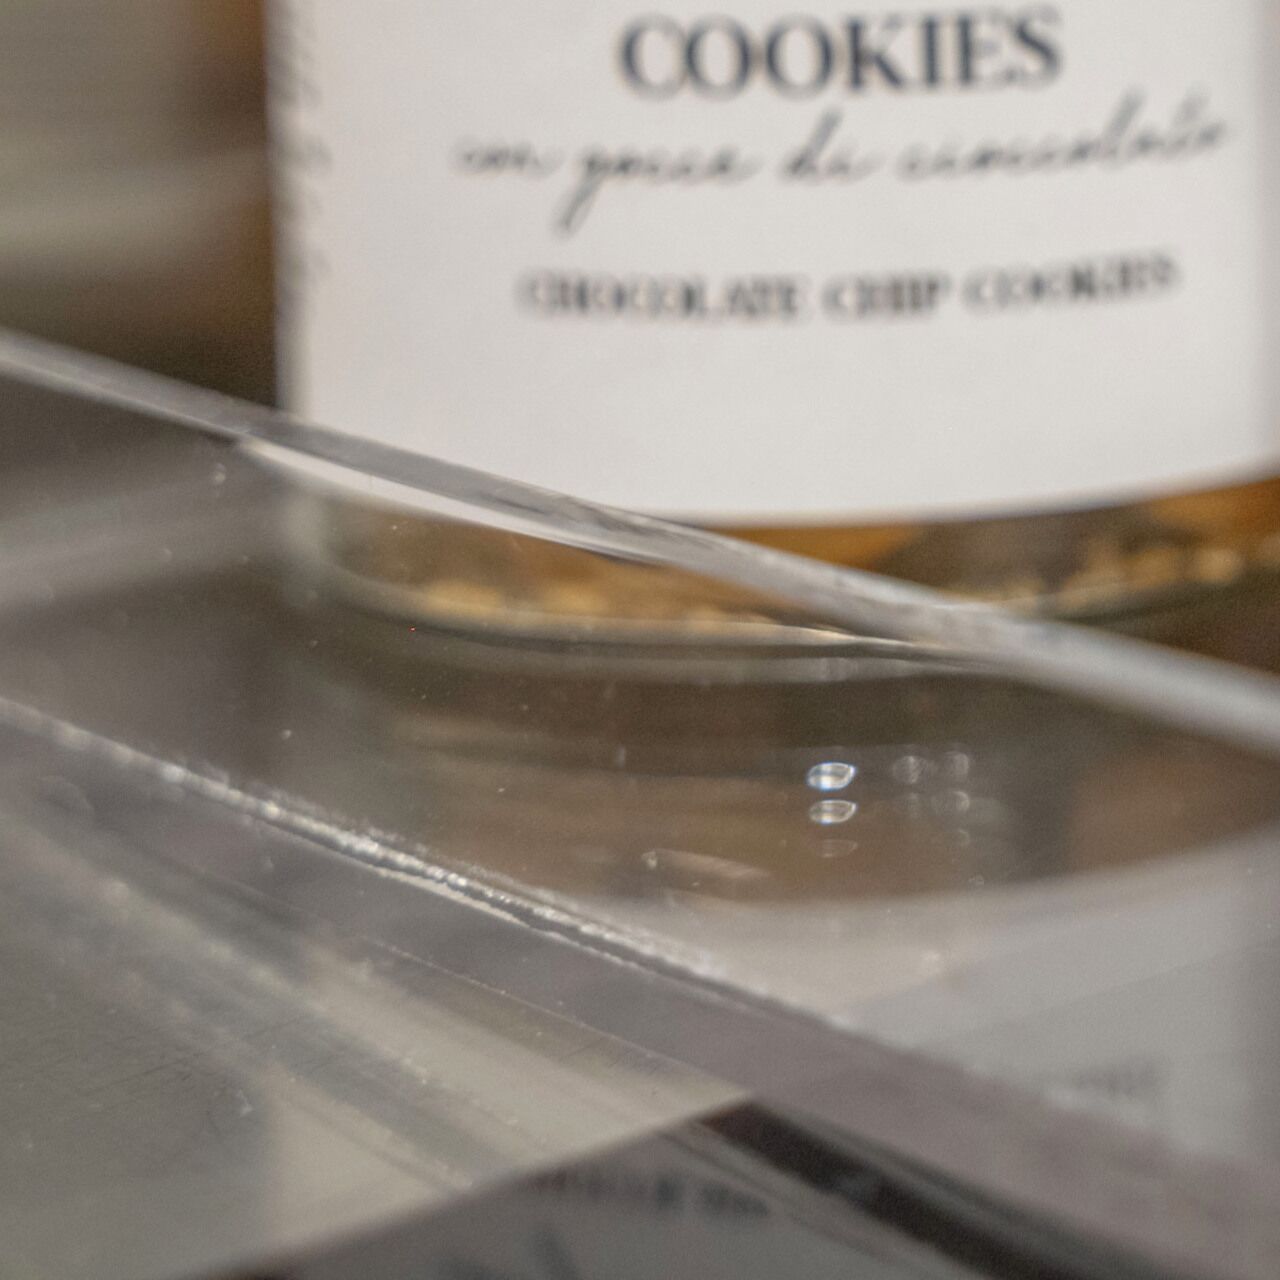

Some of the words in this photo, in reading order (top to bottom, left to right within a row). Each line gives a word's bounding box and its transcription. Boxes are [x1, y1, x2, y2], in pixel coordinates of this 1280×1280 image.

[618, 4, 1065, 102] COOKIES
[455, 132, 554, 184] con
[779, 107, 873, 186] di
[516, 268, 810, 322] CHOCOLATE
[823, 271, 954, 322] CHIP
[962, 250, 1180, 314] COOKIES
